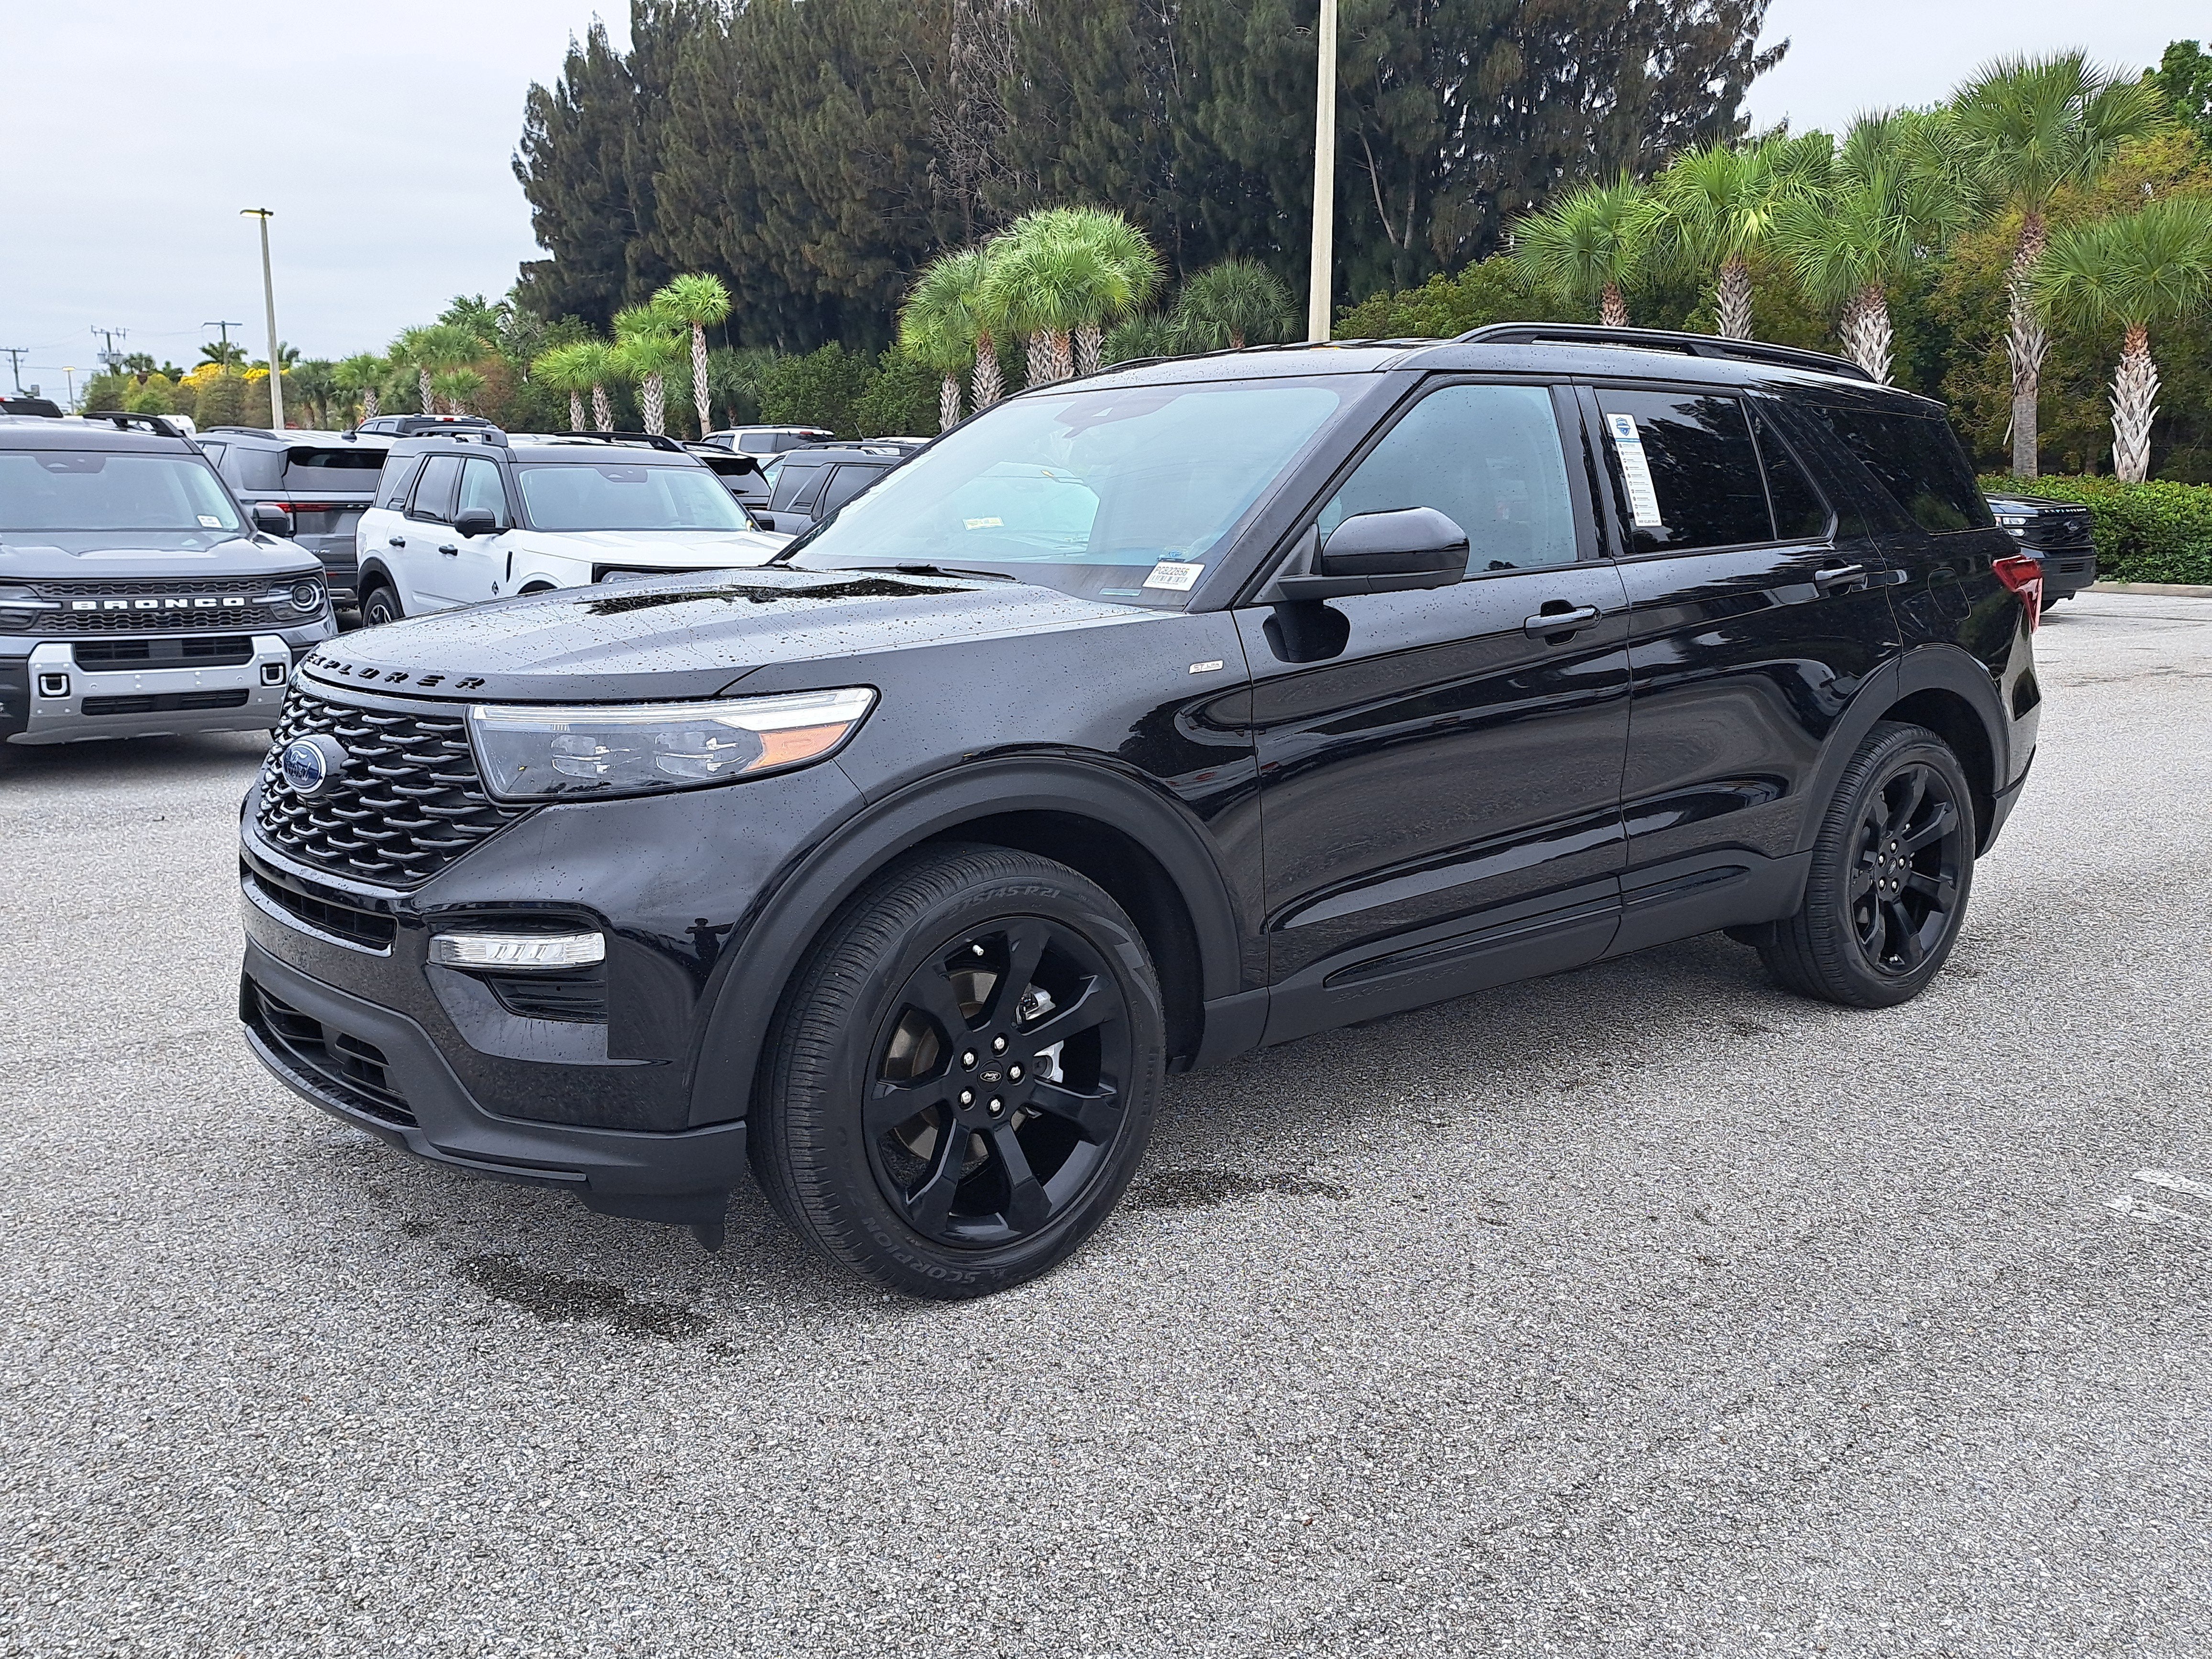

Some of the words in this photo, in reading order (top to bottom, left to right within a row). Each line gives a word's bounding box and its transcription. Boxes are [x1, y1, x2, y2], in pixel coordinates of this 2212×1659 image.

[72, 597, 245, 610] BRONCO
[306, 653, 486, 690] EXPLORER
[861, 1217, 981, 1284] SCORPION
